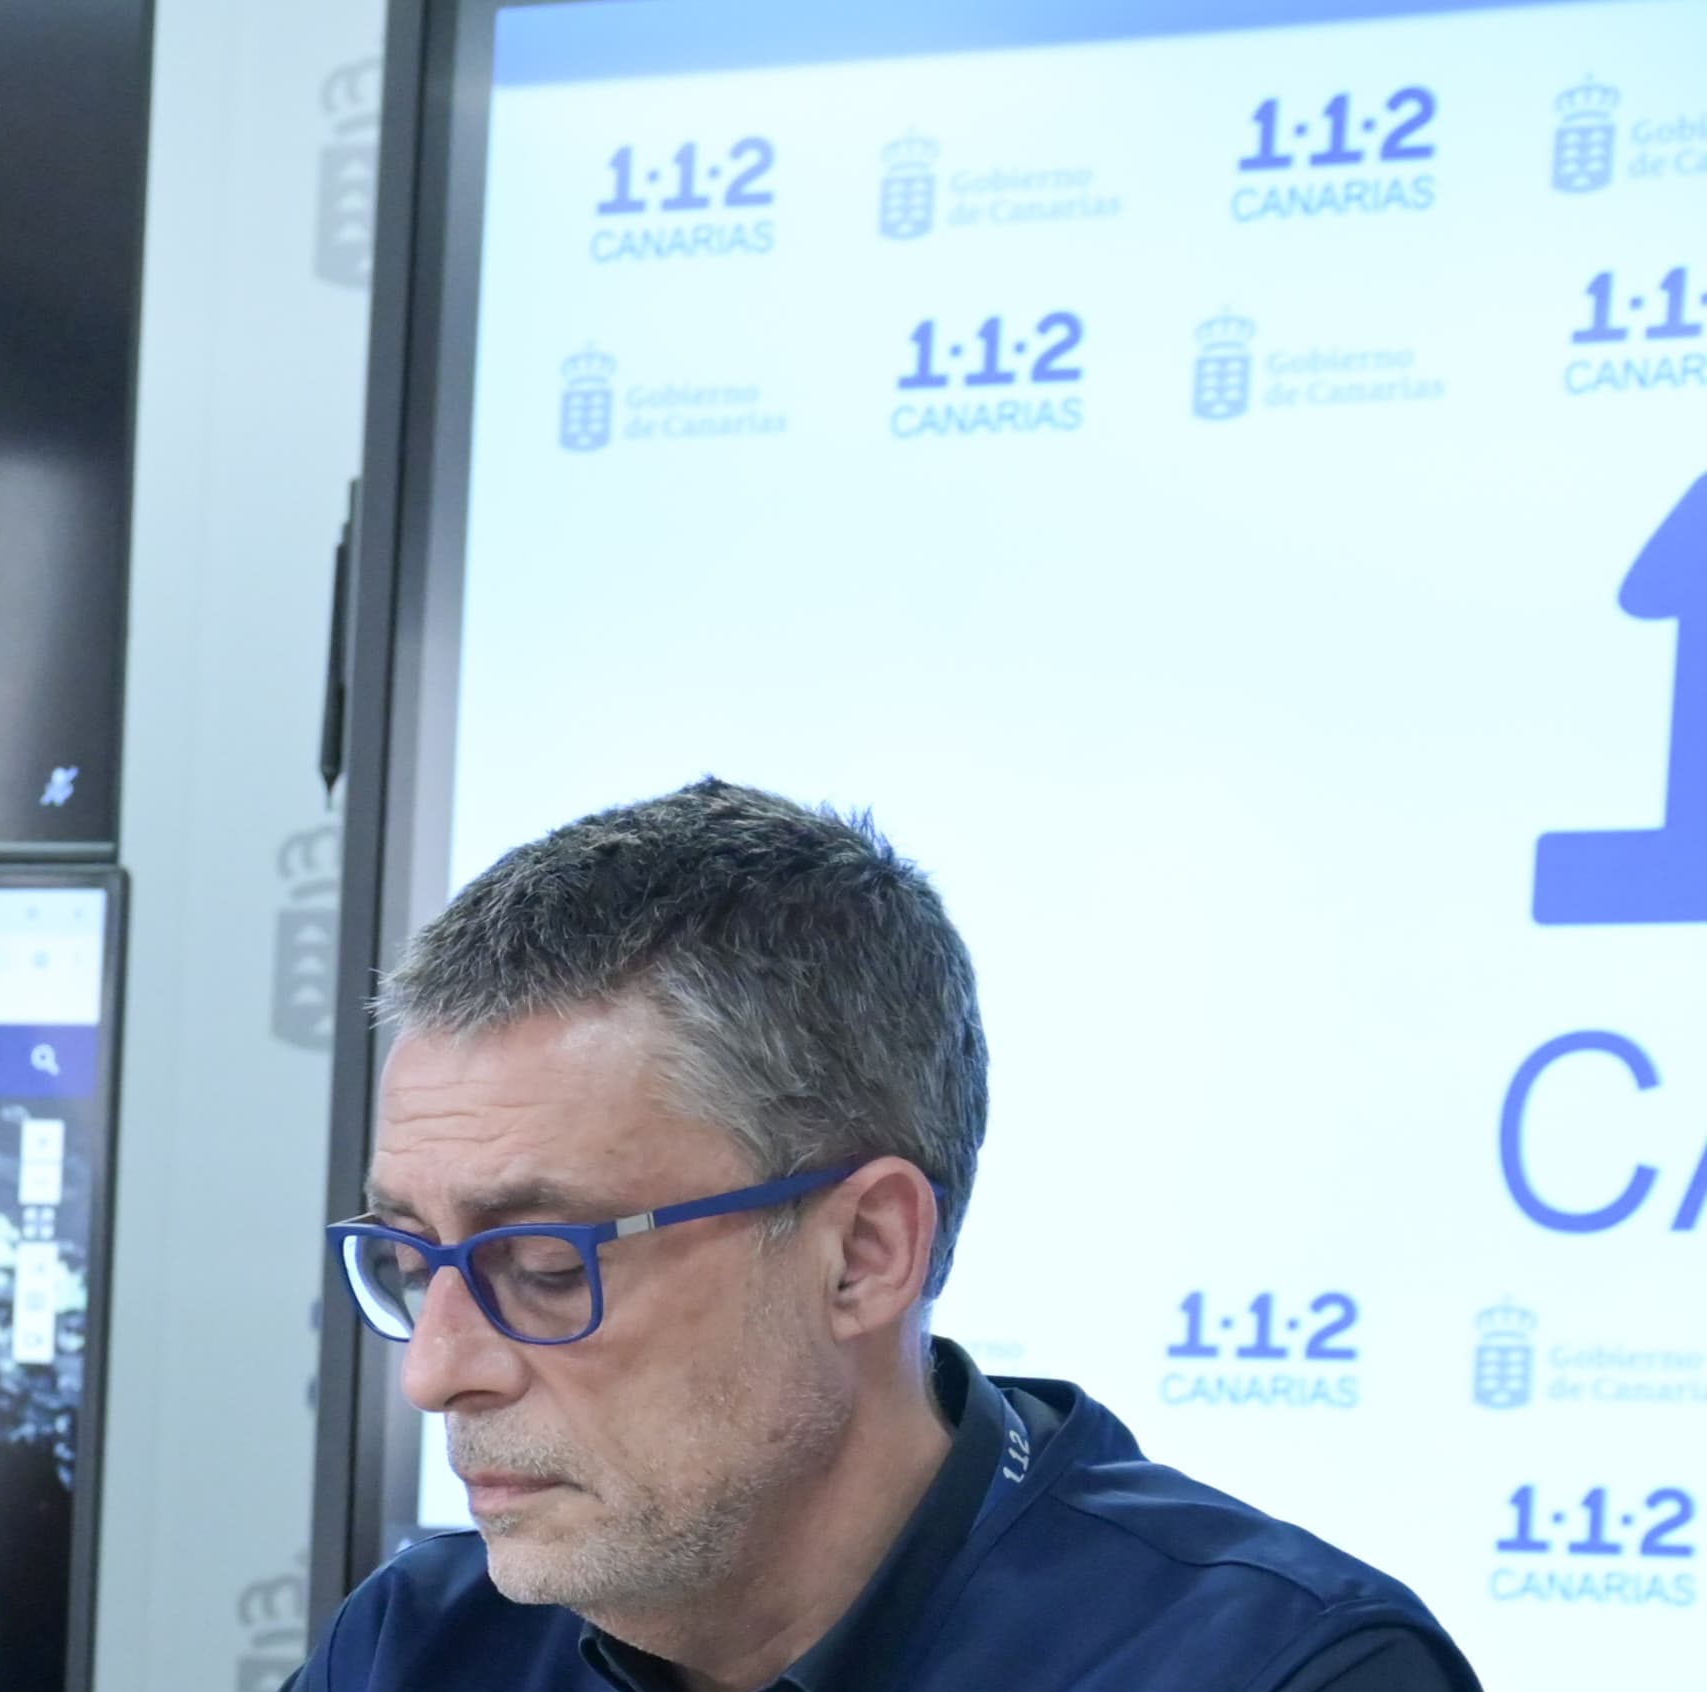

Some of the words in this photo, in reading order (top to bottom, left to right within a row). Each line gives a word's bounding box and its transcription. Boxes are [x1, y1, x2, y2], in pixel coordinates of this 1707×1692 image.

[1230, 174, 1437, 223] CANARIAS
[590, 222, 775, 263] CANARIAS
[890, 397, 1084, 440] CANARIAS
[1161, 1373, 1358, 1410] CANARIAS
[1489, 1568, 1696, 1607] CANARIAS
